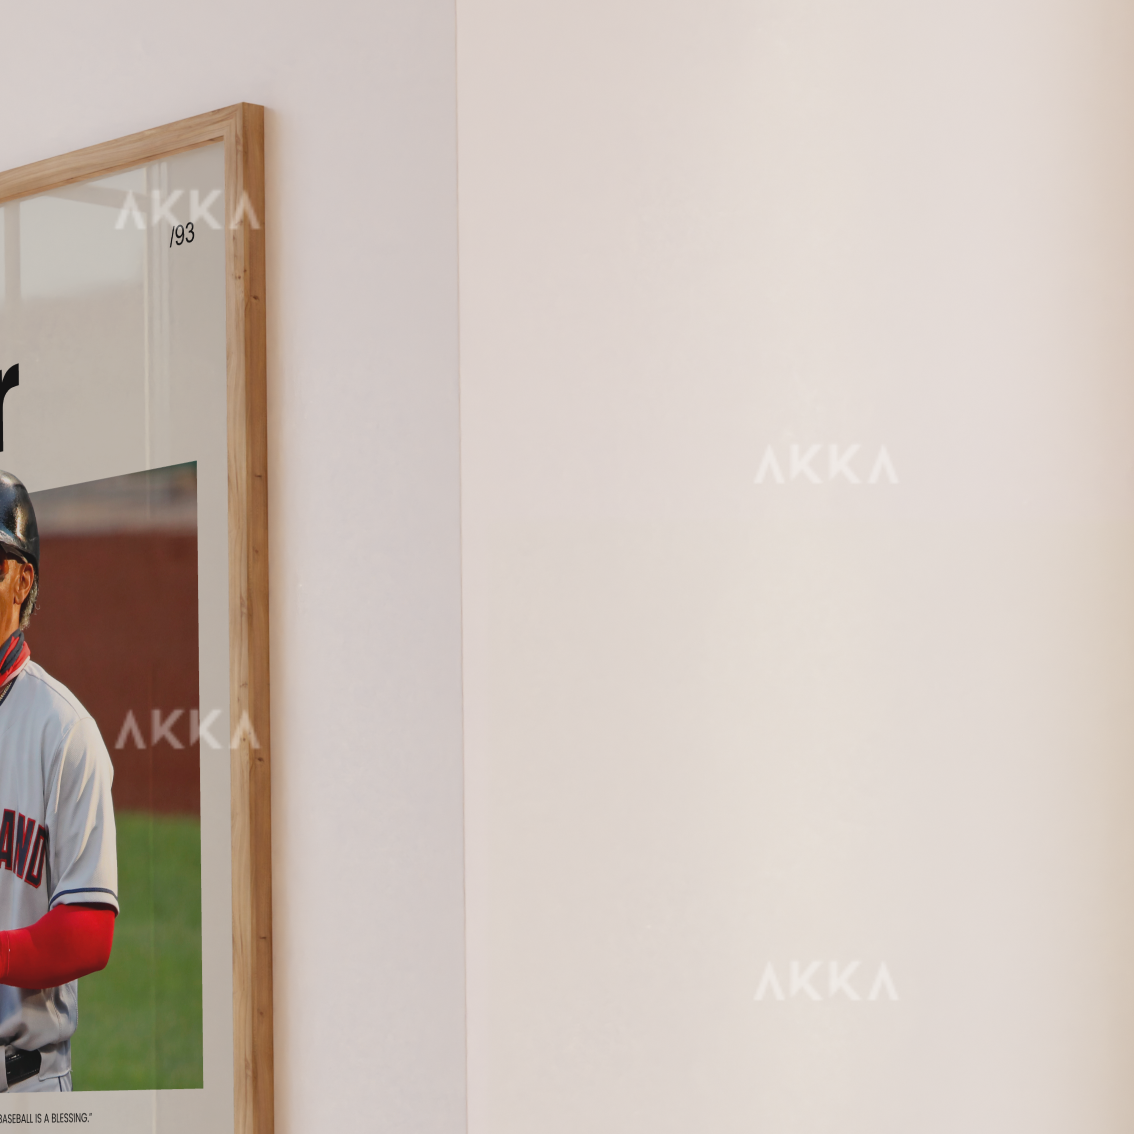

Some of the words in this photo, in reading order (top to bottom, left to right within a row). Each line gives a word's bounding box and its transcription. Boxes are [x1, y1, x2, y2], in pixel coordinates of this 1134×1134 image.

[169, 222, 195, 248] /93
[35, 1113, 42, 1123] IS
[44, 1113, 49, 1123] A
